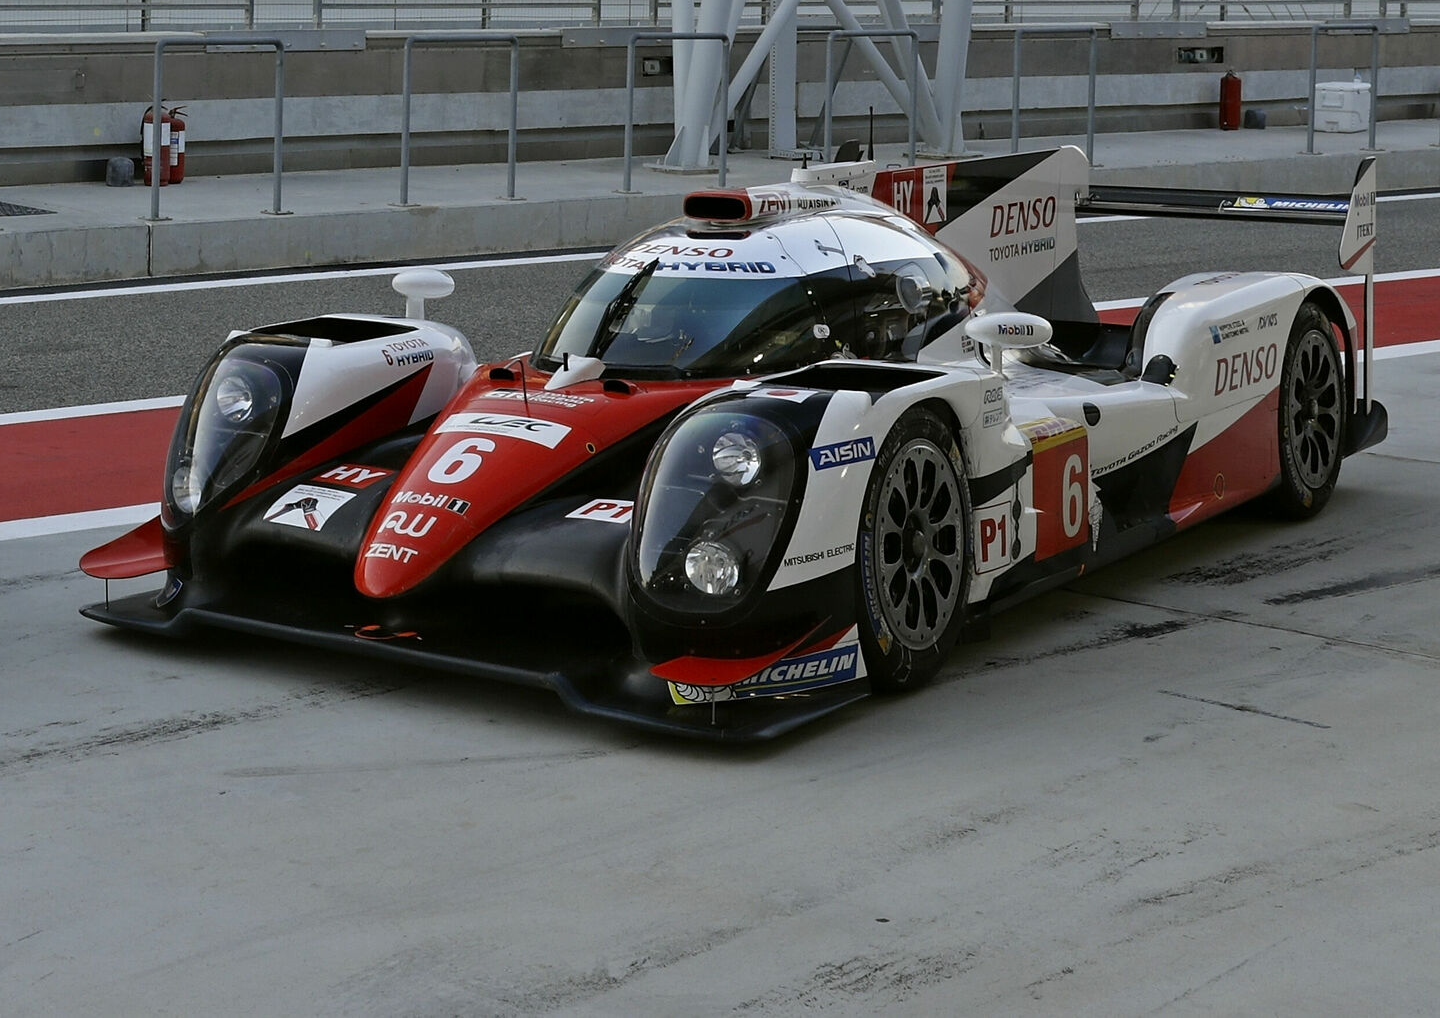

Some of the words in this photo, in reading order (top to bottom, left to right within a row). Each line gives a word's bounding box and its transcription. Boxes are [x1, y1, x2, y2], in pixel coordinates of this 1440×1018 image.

[894, 180, 914, 214] HY
[989, 195, 1057, 239] DENSO
[627, 243, 734, 259] DENSO
[989, 244, 1020, 263] TOYOTA
[1021, 236, 1056, 258] HYBRID
[657, 261, 776, 274] HYBRID
[998, 325, 1025, 336] Mobil
[386, 338, 429, 352] TOYOTA
[381, 349, 394, 366] 6
[396, 349, 435, 367] HYBRID
[1214, 343, 1278, 396] DENSO
[470, 416, 553, 432] WEC
[427, 438, 496, 483] 6
[818, 440, 874, 466] AISIN
[320, 465, 388, 484] HY
[1091, 457, 1126, 476] TOYOTA
[391, 491, 449, 508] Mobil
[1062, 454, 1085, 538] 6
[583, 502, 633, 519] P1
[980, 513, 1008, 564] P1
[364, 543, 419, 564] ZENT
[783, 551, 825, 567] MITSUBISHI
[827, 542, 855, 558] ELECTRIC
